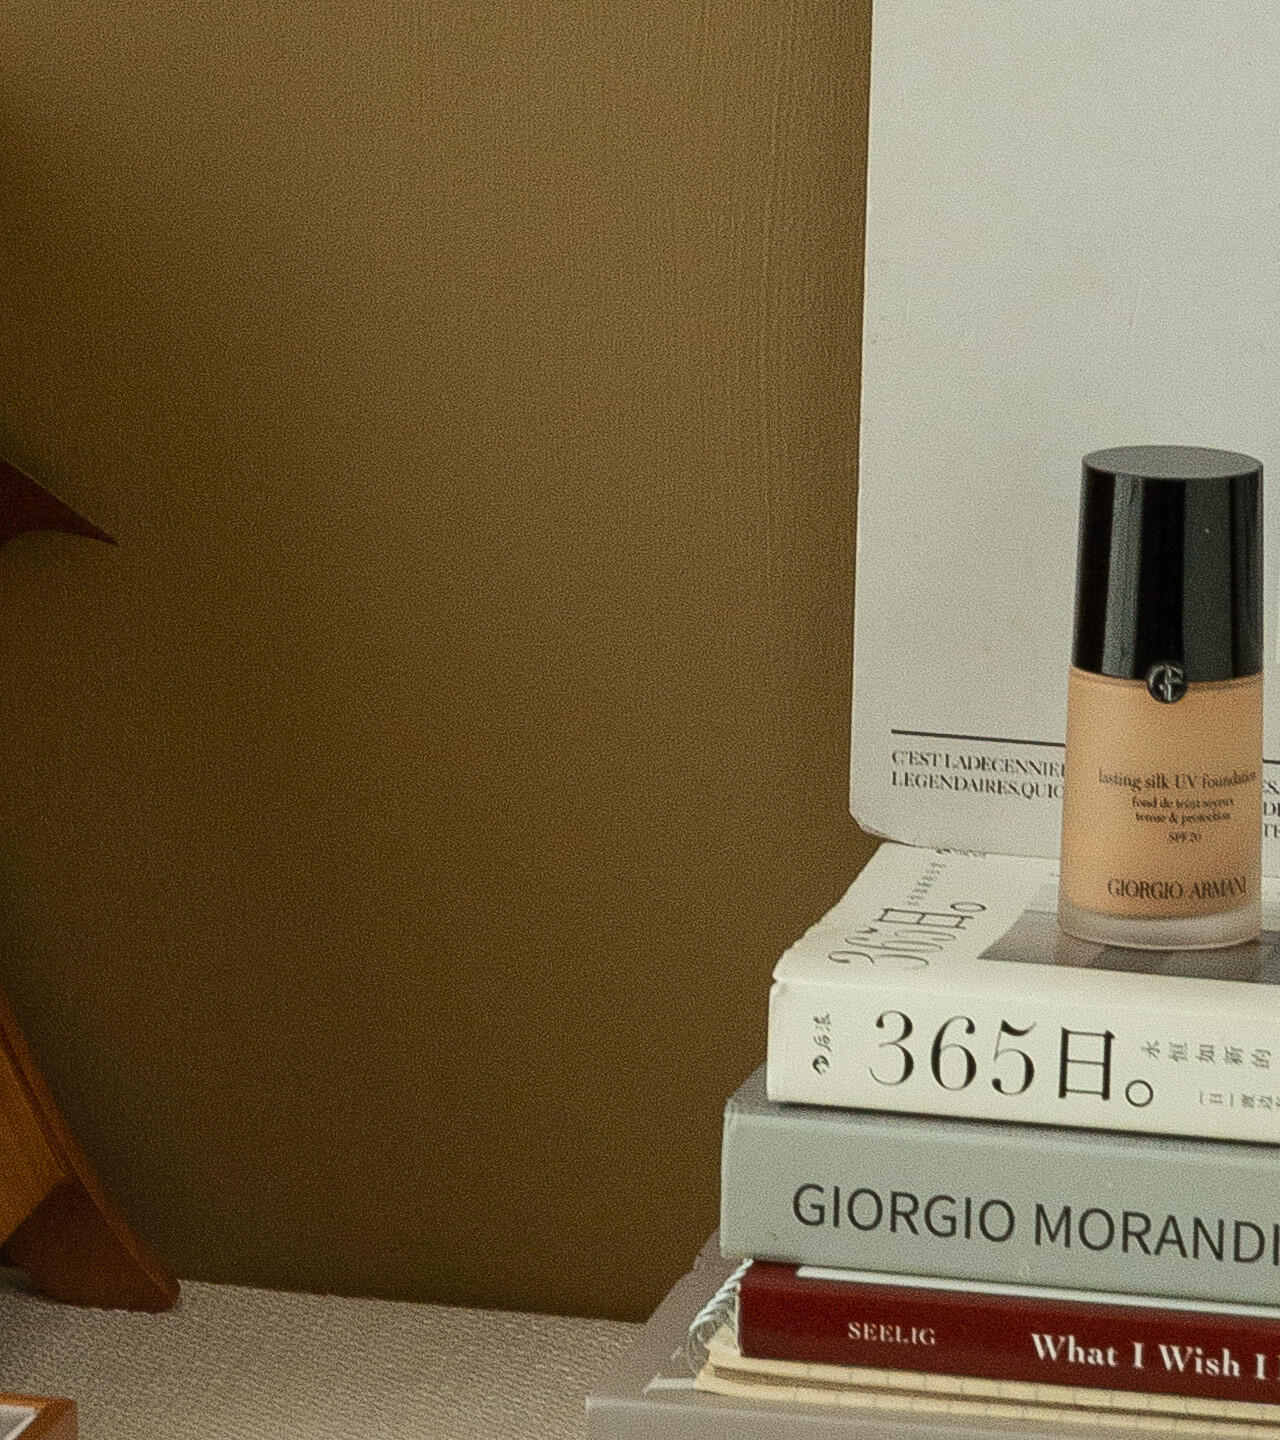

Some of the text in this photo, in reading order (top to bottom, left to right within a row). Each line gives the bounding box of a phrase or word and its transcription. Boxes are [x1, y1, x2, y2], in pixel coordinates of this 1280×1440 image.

[1144, 772, 1170, 790] silk
[1107, 878, 1183, 900] GIORGIO
[792, 1182, 1280, 1267] GIORGIO MORANDI
[847, 1321, 937, 1347] SEELIG
[1030, 1332, 1267, 1381] What I Wish I
